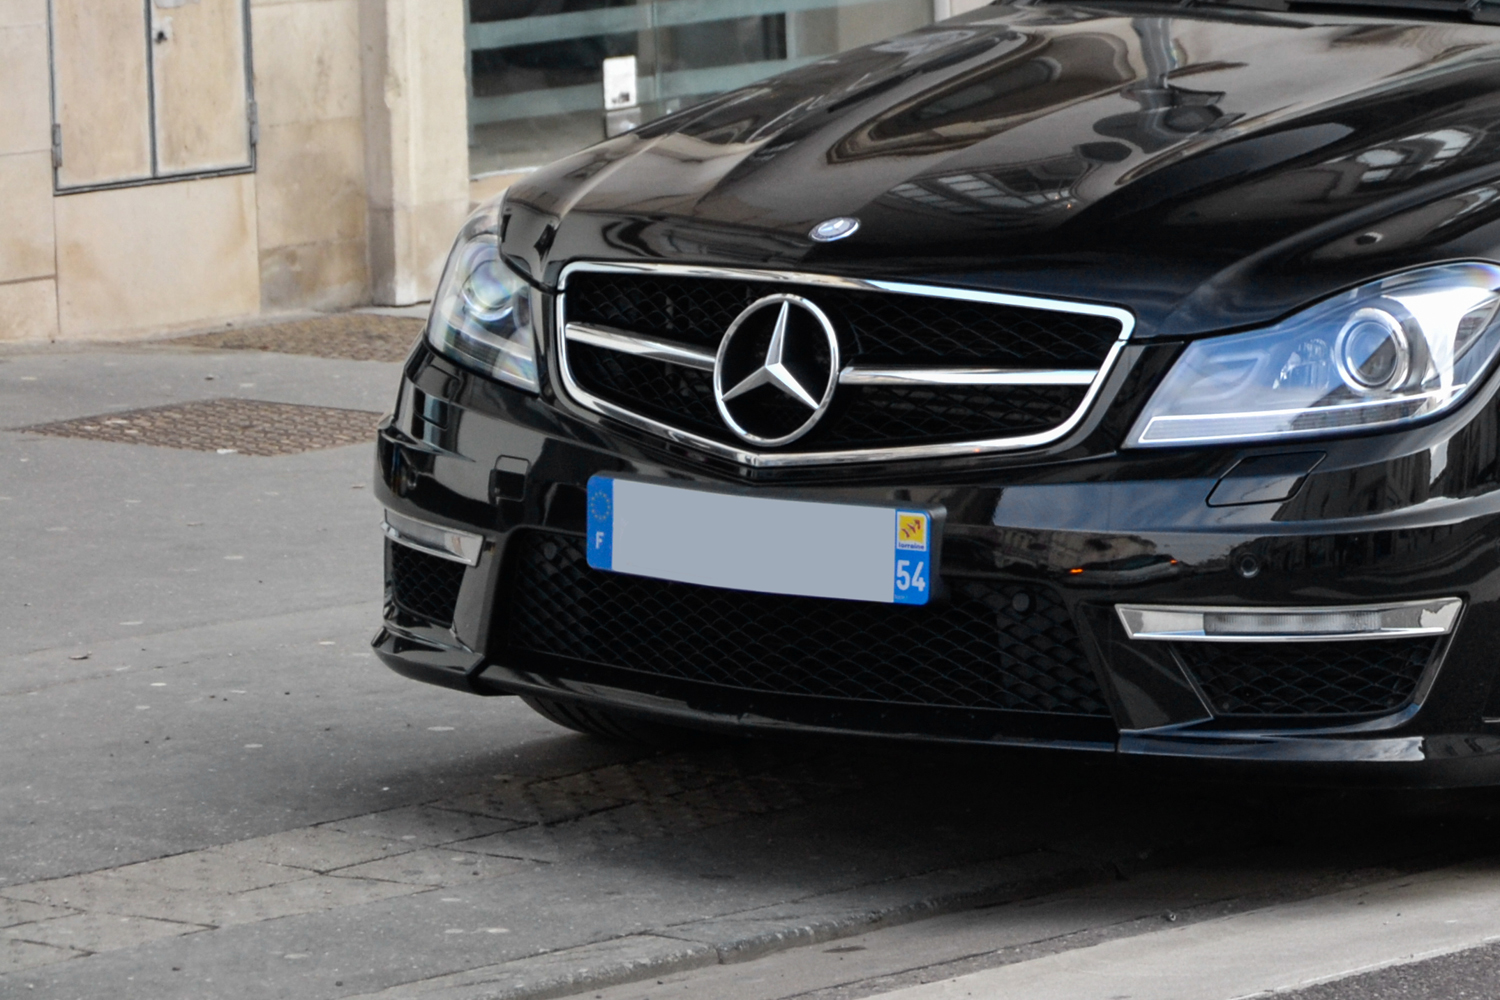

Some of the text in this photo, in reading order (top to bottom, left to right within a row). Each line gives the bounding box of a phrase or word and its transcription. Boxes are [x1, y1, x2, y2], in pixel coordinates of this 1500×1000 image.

[594, 531, 605, 550] F
[897, 541, 925, 551] lorraine
[896, 559, 926, 592] 54
